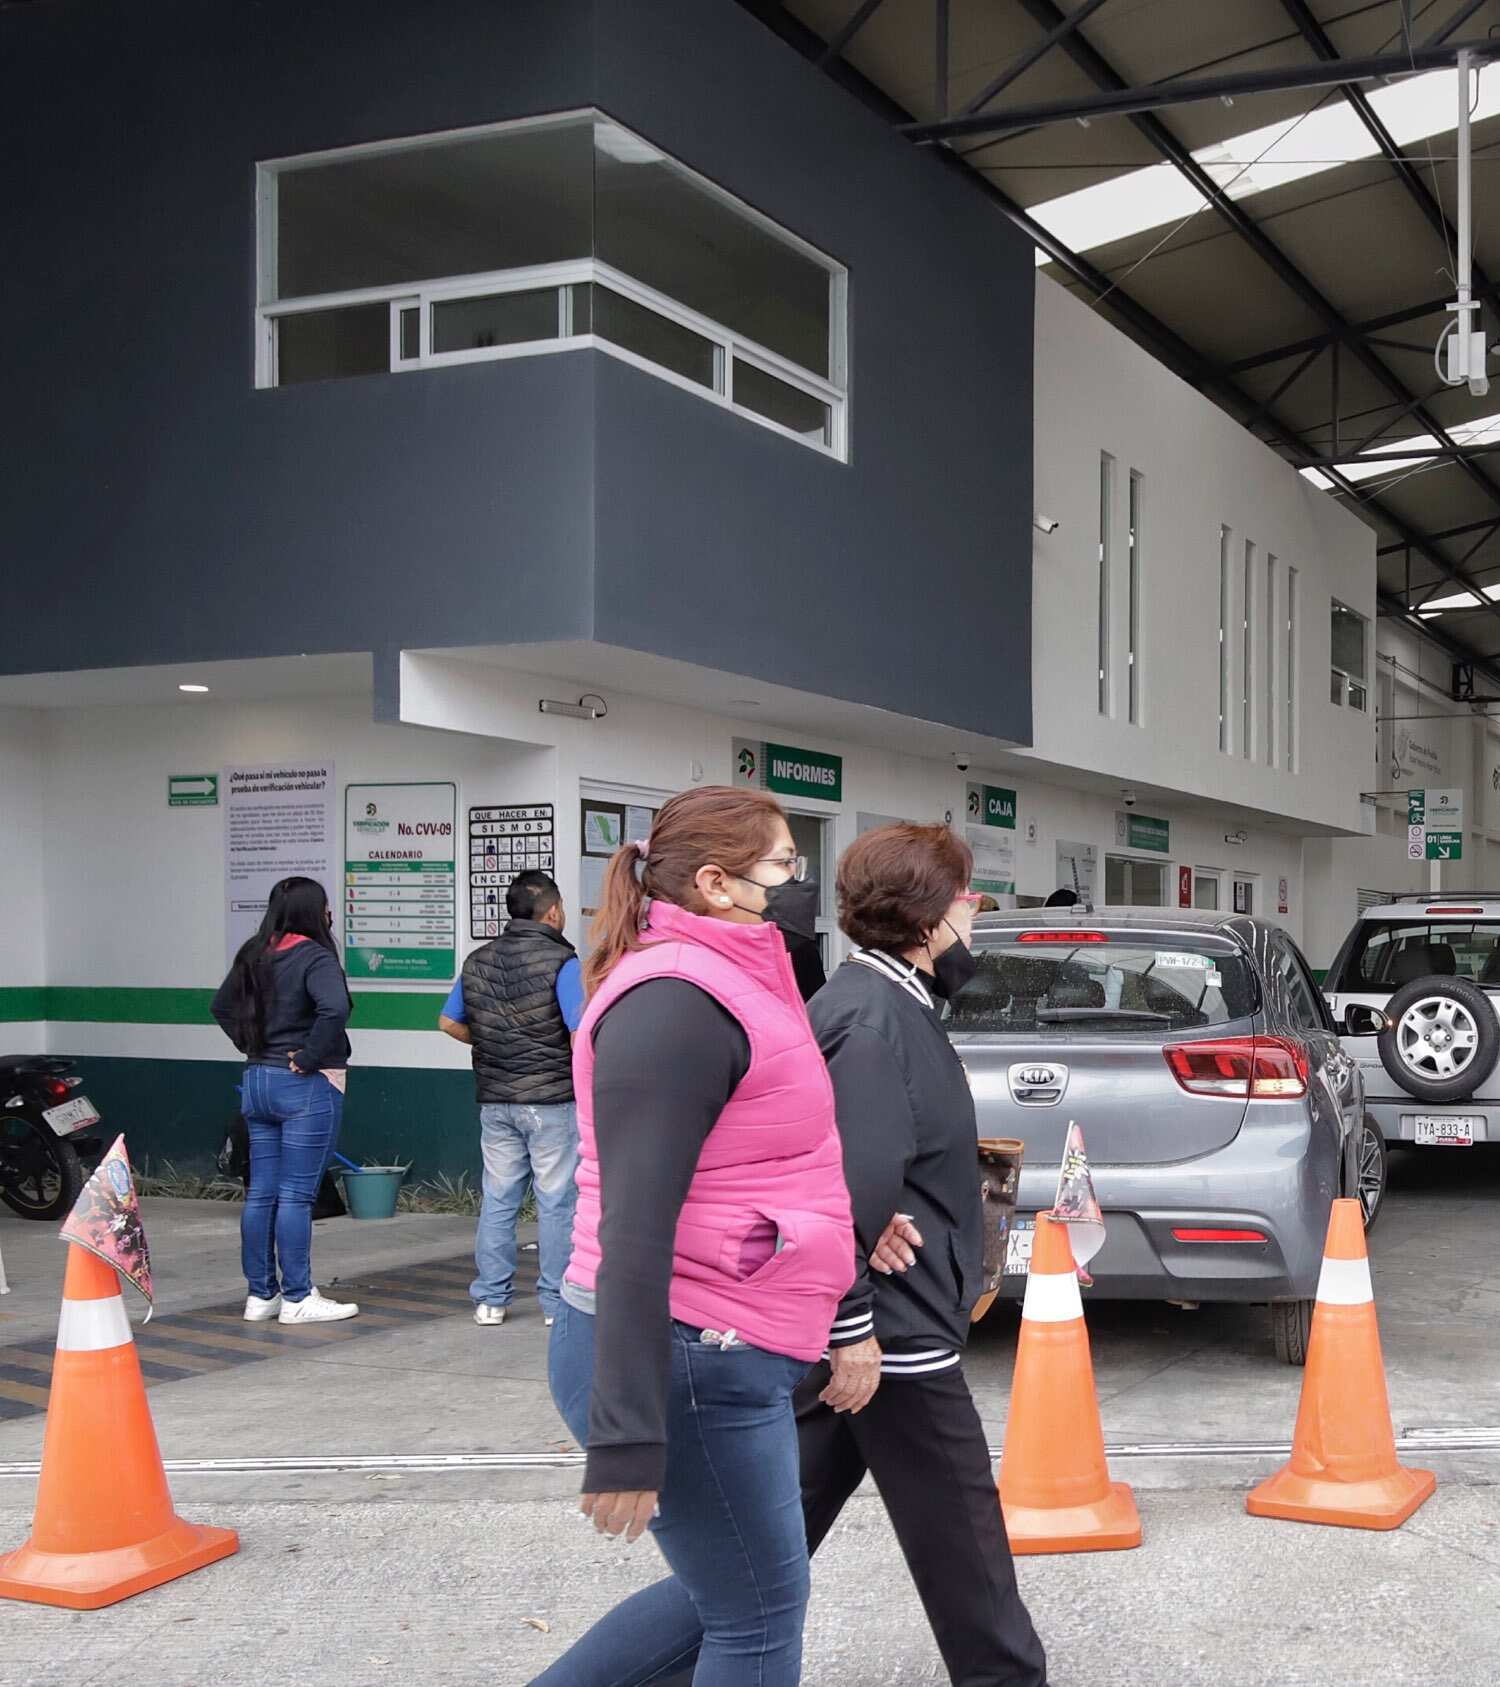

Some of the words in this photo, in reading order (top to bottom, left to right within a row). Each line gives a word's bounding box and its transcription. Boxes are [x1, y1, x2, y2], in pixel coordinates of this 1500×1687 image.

[245, 773, 259, 782] pasa
[772, 759, 836, 786] INFORMES
[231, 785, 251, 796] prueba
[252, 784, 260, 792] de
[988, 798, 1013, 817] CAJA
[474, 811, 492, 820] QUE
[498, 810, 527, 819] HACER
[397, 822, 414, 836] No.
[415, 822, 452, 836] CVV-09
[481, 822, 544, 833] SISMOS
[1427, 835, 1437, 844] 01
[368, 850, 423, 860] CALENDARIO
[1023, 1070, 1051, 1082] KIA
[1417, 1122, 1470, 1136] TYA-833-A
